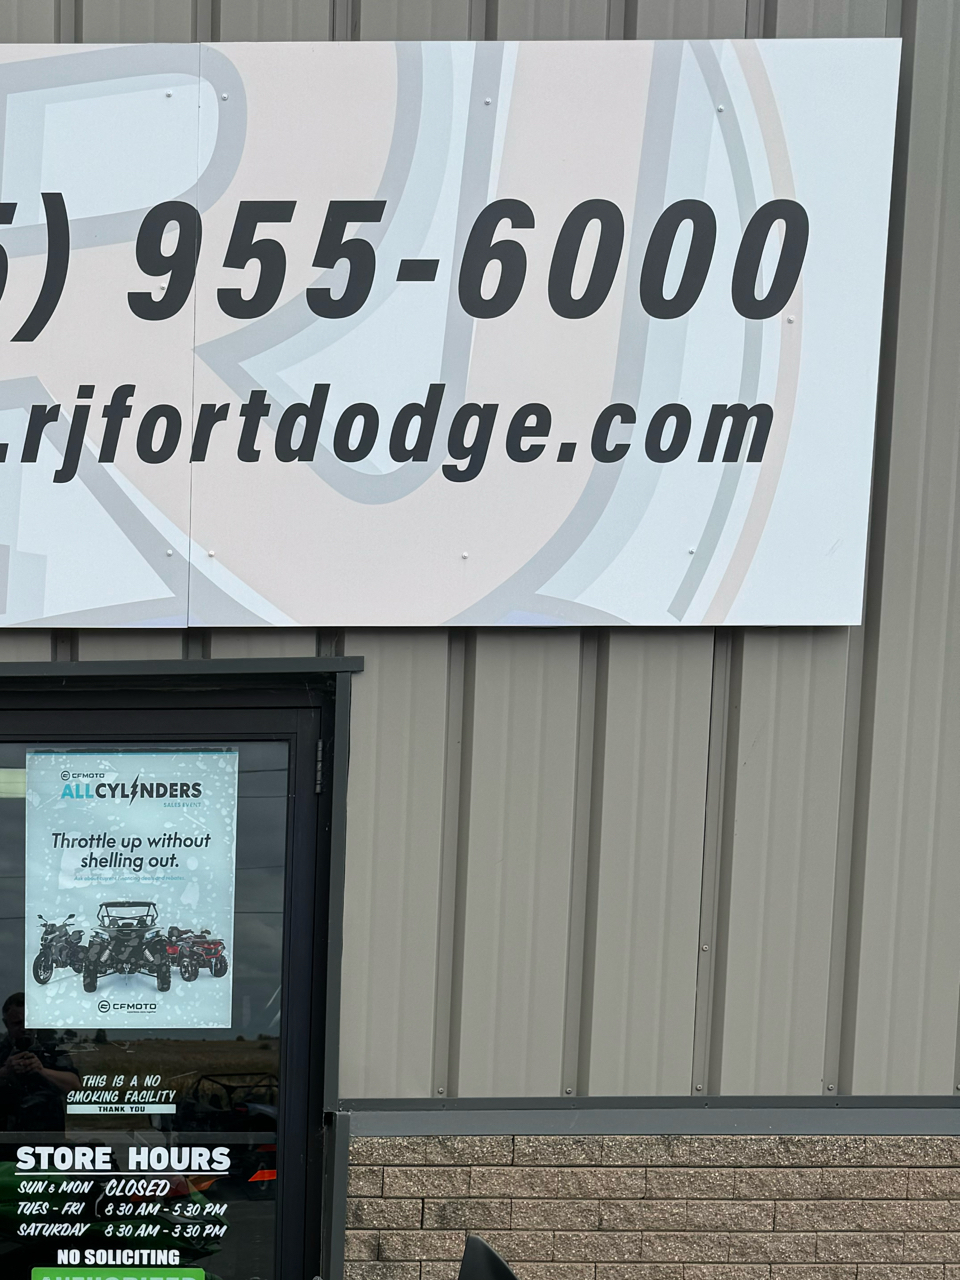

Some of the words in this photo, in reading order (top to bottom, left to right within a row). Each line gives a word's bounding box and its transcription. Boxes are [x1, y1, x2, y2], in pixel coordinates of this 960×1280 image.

[126, 198, 810, 320] 955-6000
[51, 832, 117, 849] Throttle
[121, 836, 143, 852] up
[147, 832, 212, 849] without
[80, 852, 144, 872] shelling
[148, 852, 180, 868] out.
[82, 1075, 107, 1087] THIS
[112, 1075, 124, 1087] IS
[130, 1075, 138, 1086] A
[144, 1075, 161, 1086] NO
[67, 1090, 119, 1103] SMOKING
[124, 1090, 176, 1102] FACILITY
[16, 1146, 112, 1171] STORE
[128, 1146, 231, 1171] HOURS
[18, 1181, 48, 1194] SUN
[58, 1181, 94, 1194] MON
[105, 1179, 171, 1197] CLOSED
[17, 1202, 49, 1215] TUES
[61, 1202, 86, 1215] FRI
[135, 1202, 161, 1216] AM
[203, 1203, 228, 1216] PM
[17, 1223, 90, 1236] SATURDAY
[134, 1224, 161, 1237] AM
[203, 1225, 228, 1238] PM
[57, 1249, 81, 1265] NO
[84, 1249, 180, 1265] SOLICITING
